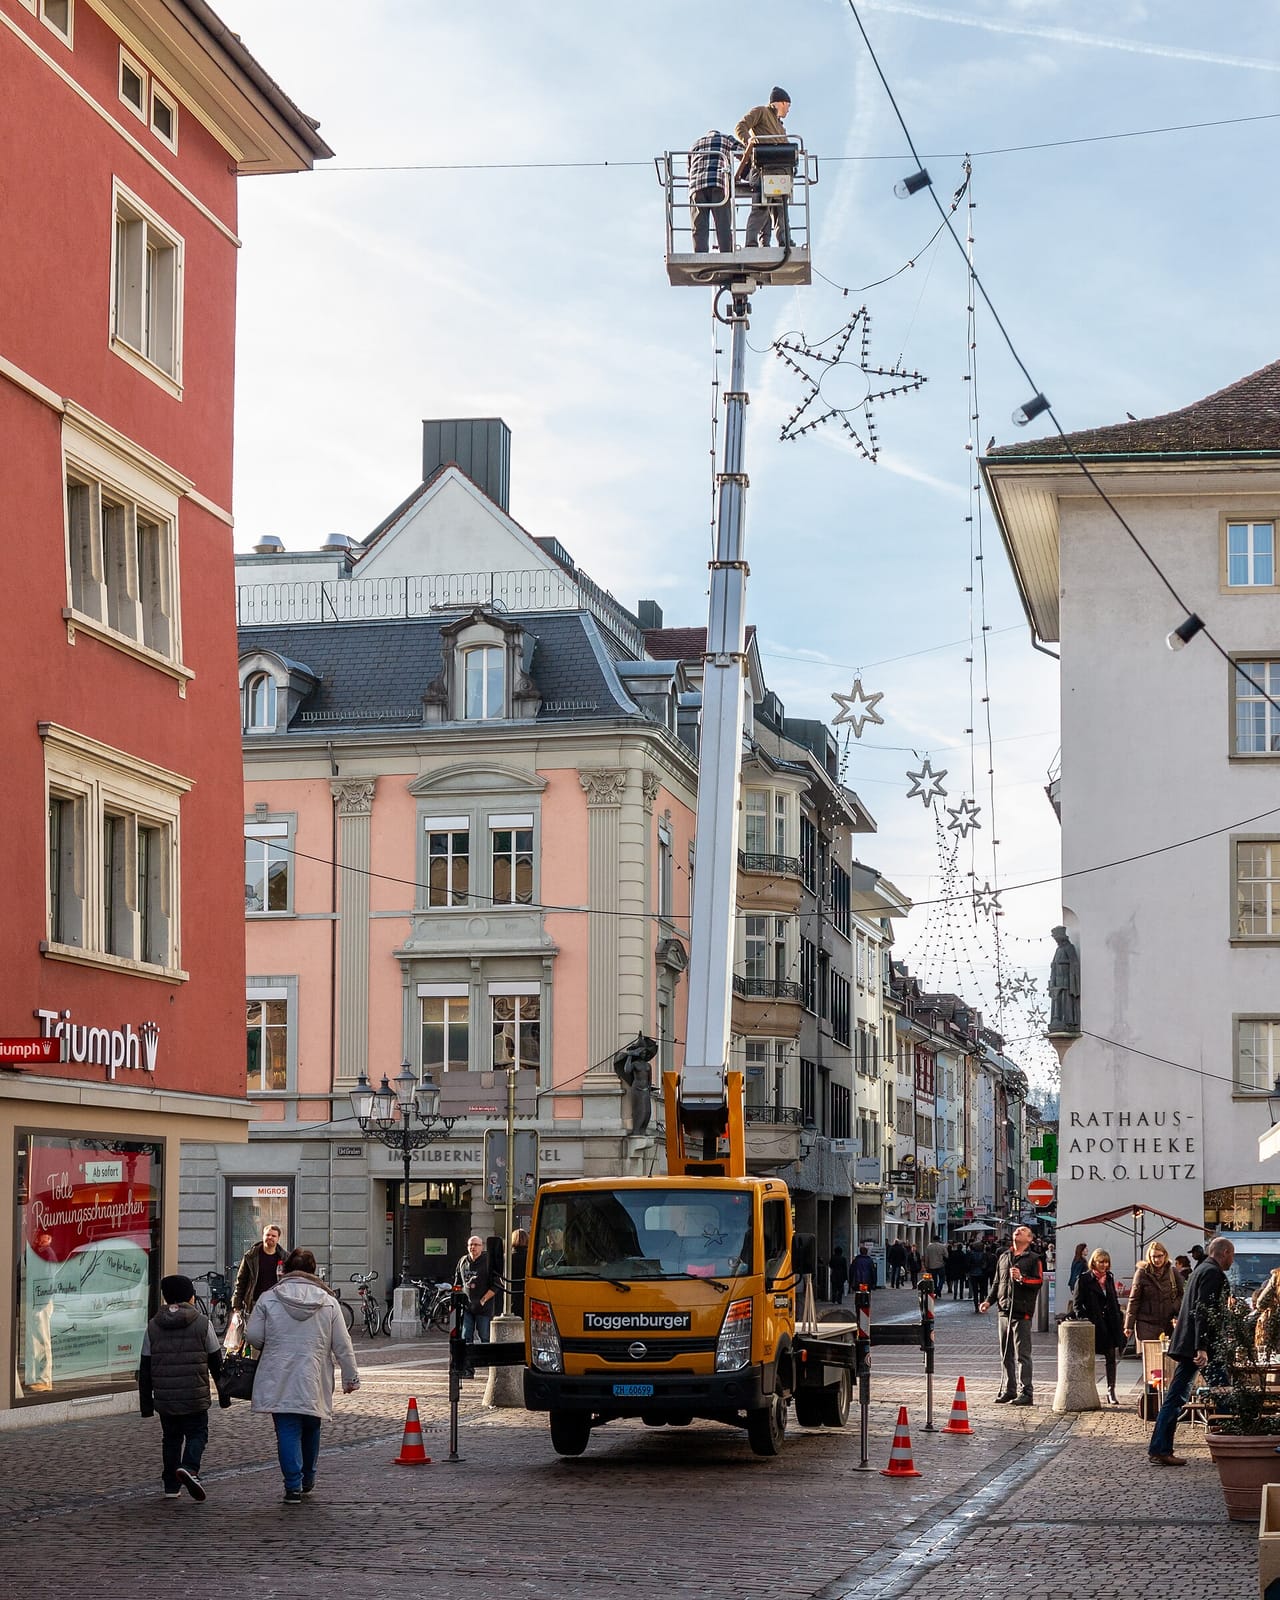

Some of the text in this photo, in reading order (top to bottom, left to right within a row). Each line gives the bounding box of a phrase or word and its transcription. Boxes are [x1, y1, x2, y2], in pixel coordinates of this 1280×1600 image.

[36, 1009, 139, 1080] Triumph
[1070, 1111, 1194, 1128] RATHAUS-
[1069, 1137, 1195, 1153] APOTHEKE
[388, 1150, 404, 1161] IM
[412, 1150, 481, 1162] SILBERNE
[93, 1165, 119, 1177] Ab sofort
[1071, 1164, 1196, 1181] DR. O. LUTZ
[46, 1171, 75, 1200] Tolle
[585, 1313, 689, 1330] Toggenburger
[615, 1385, 652, 1394] ZH 60699
